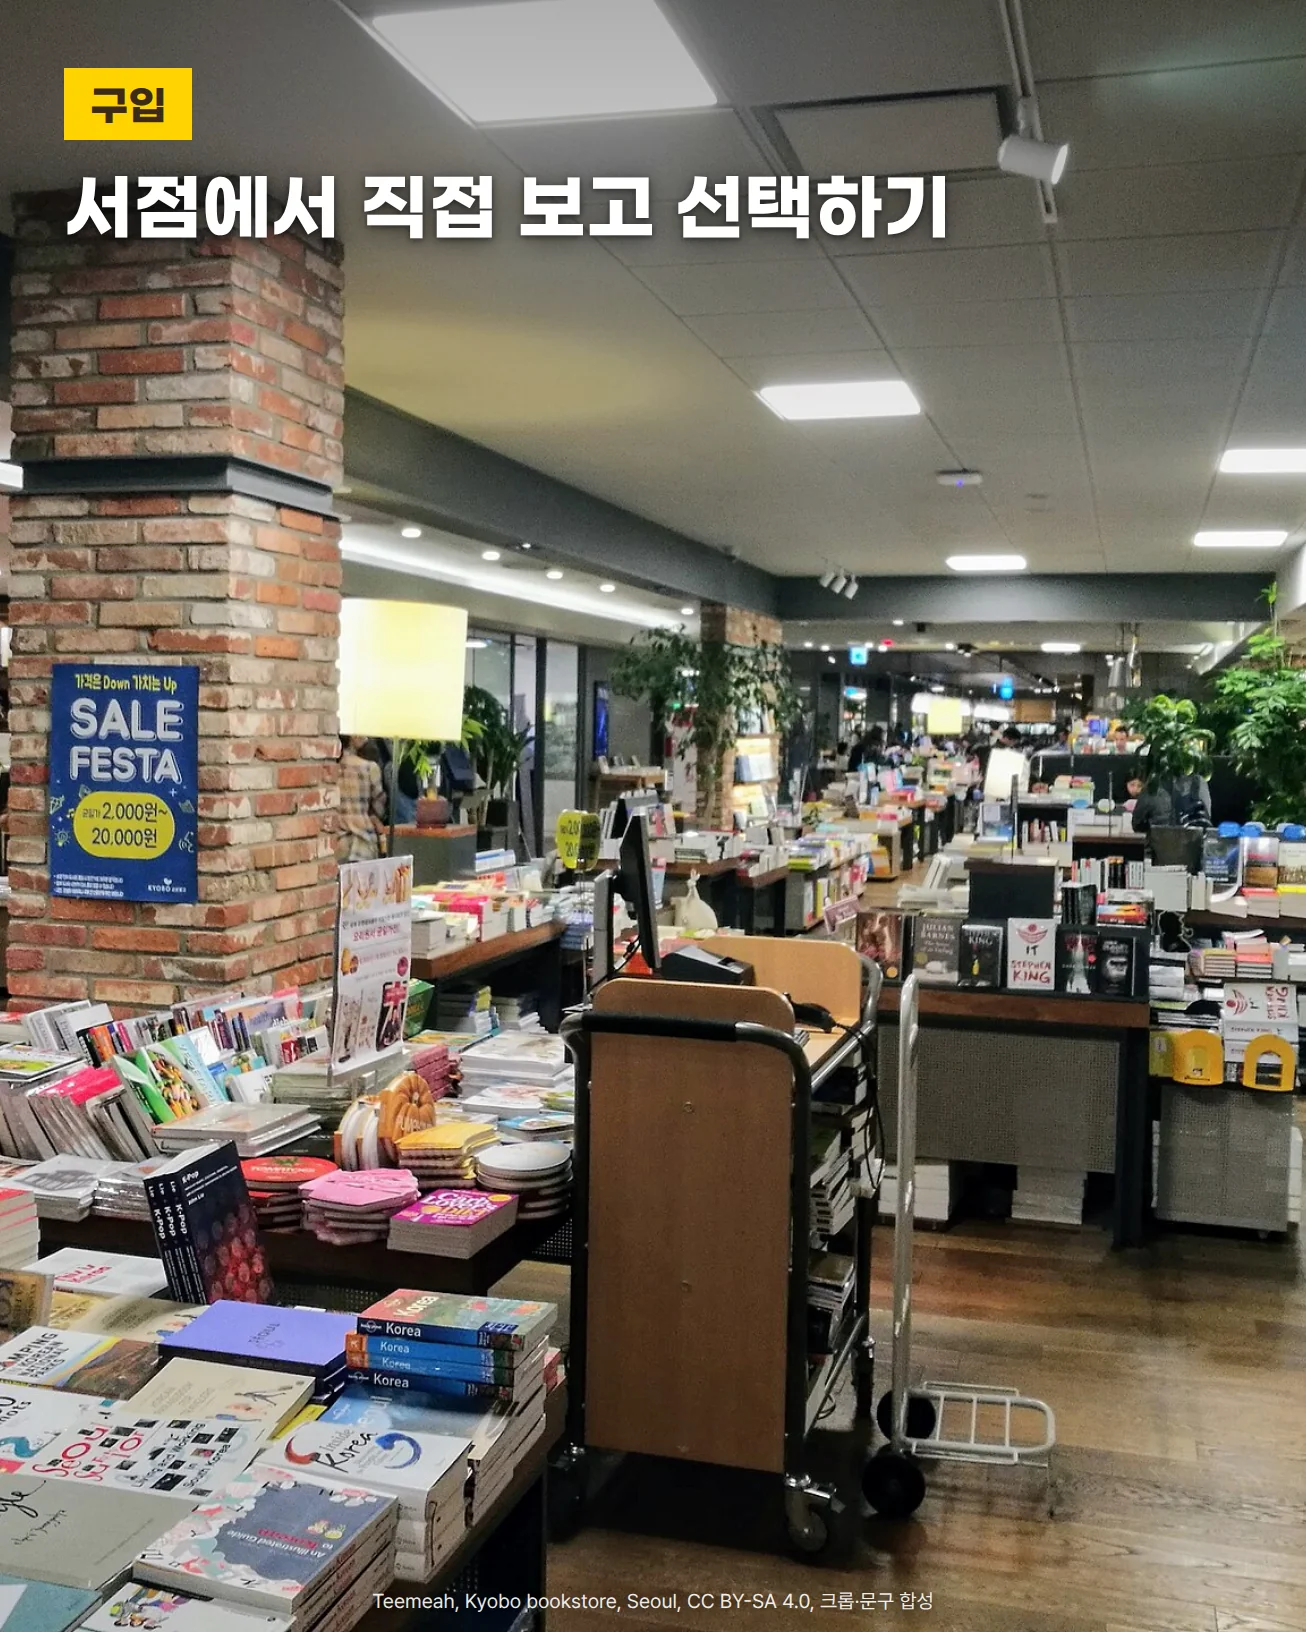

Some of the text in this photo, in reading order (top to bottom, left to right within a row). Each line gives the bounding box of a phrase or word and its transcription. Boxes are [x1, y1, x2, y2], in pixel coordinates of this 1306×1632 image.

[75, 673, 177, 695] 가격은 Down 가치는 Up
[71, 698, 184, 741] SALE
[70, 746, 183, 784] FESTA
[92, 827, 157, 849] 20,000원
[968, 936, 993, 945] KING
[1026, 945, 1039, 956] IT
[1011, 959, 1051, 970] STEPHEN
[1013, 970, 1050, 984] KING
[154, 1209, 166, 1240] K-Pop
[164, 1206, 176, 1237] K-Pop
[175, 1204, 188, 1235] K-Pop
[393, 1295, 440, 1317] Korea
[386, 1323, 421, 1337] Korea
[380, 1341, 410, 1354] Korea
[382, 1357, 411, 1371] Korea
[373, 1373, 409, 1388] Korea
[315, 1432, 378, 1473] Korea
[227, 1530, 326, 1558] An Illustrated Guide
